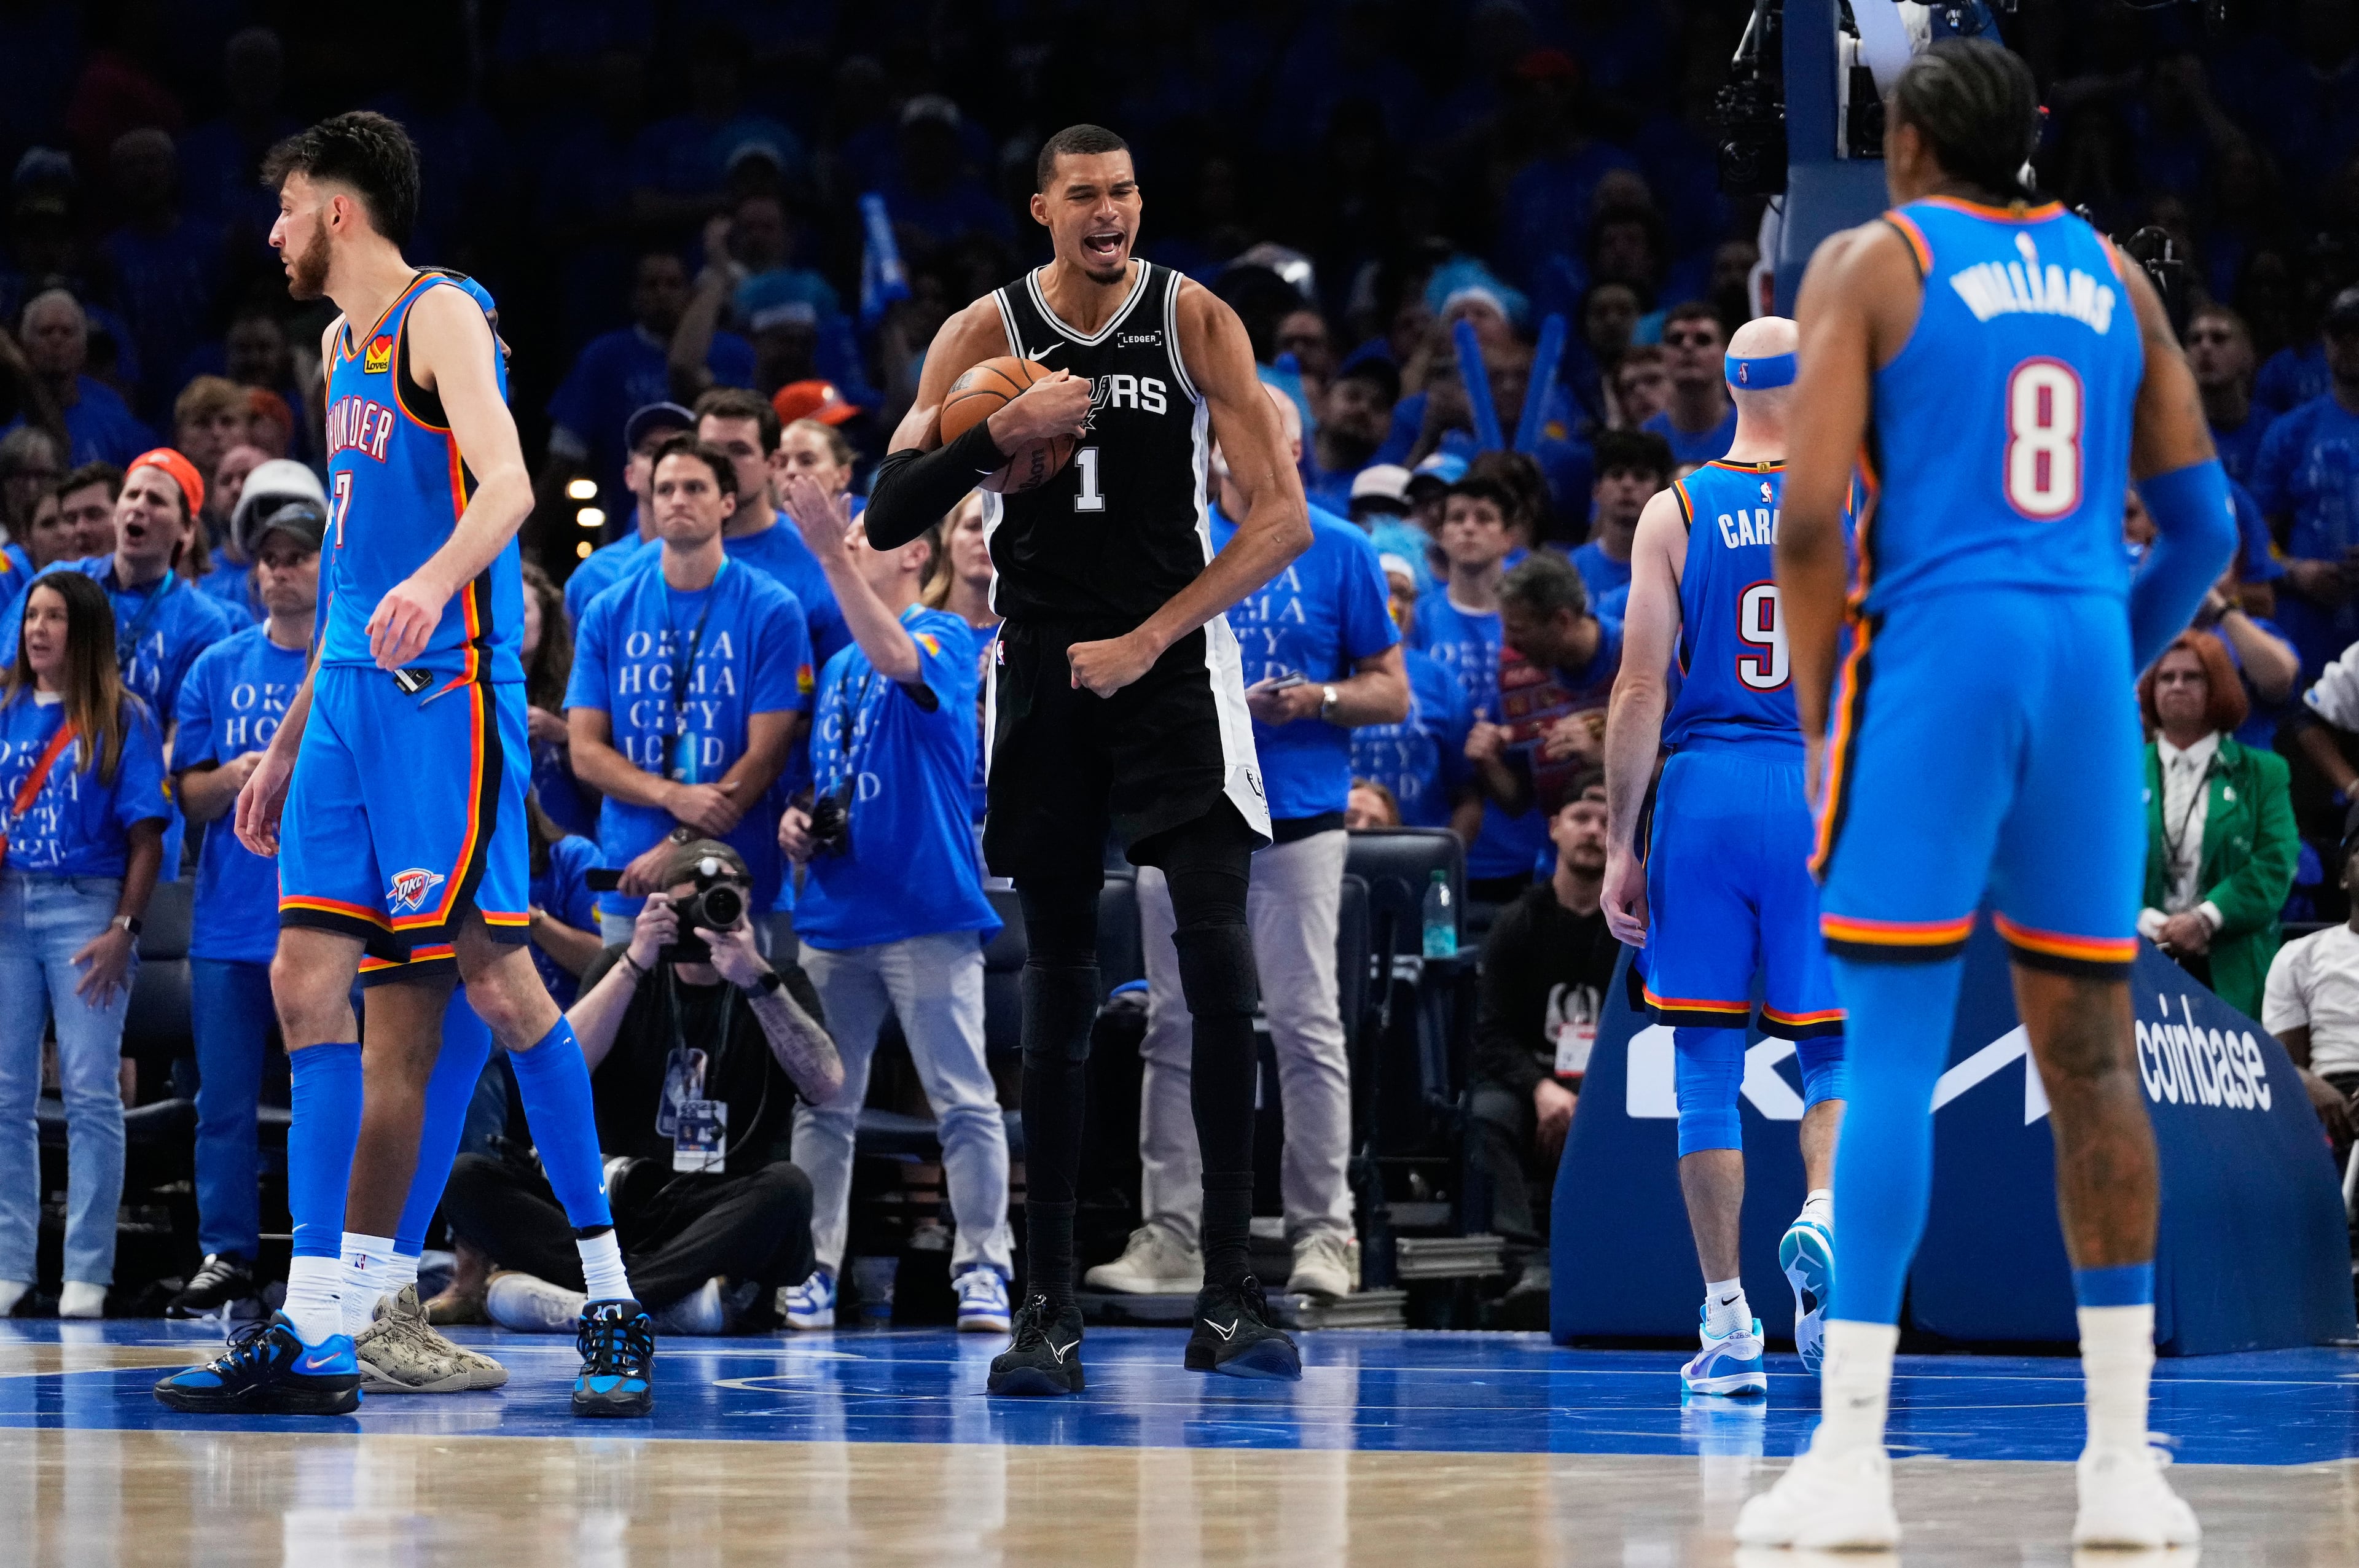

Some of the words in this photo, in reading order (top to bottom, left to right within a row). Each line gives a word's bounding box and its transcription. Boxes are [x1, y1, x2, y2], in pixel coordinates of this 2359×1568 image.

[1949, 260, 2116, 335] WILLIAMS
[326, 395, 395, 463] HUNDER
[2003, 356, 2086, 523] 8
[335, 469, 353, 548] 7
[1074, 447, 1105, 513] 1
[1737, 580, 1790, 692] 9
[398, 875, 423, 902] OKC
[2135, 993, 2271, 1112] coinbase
